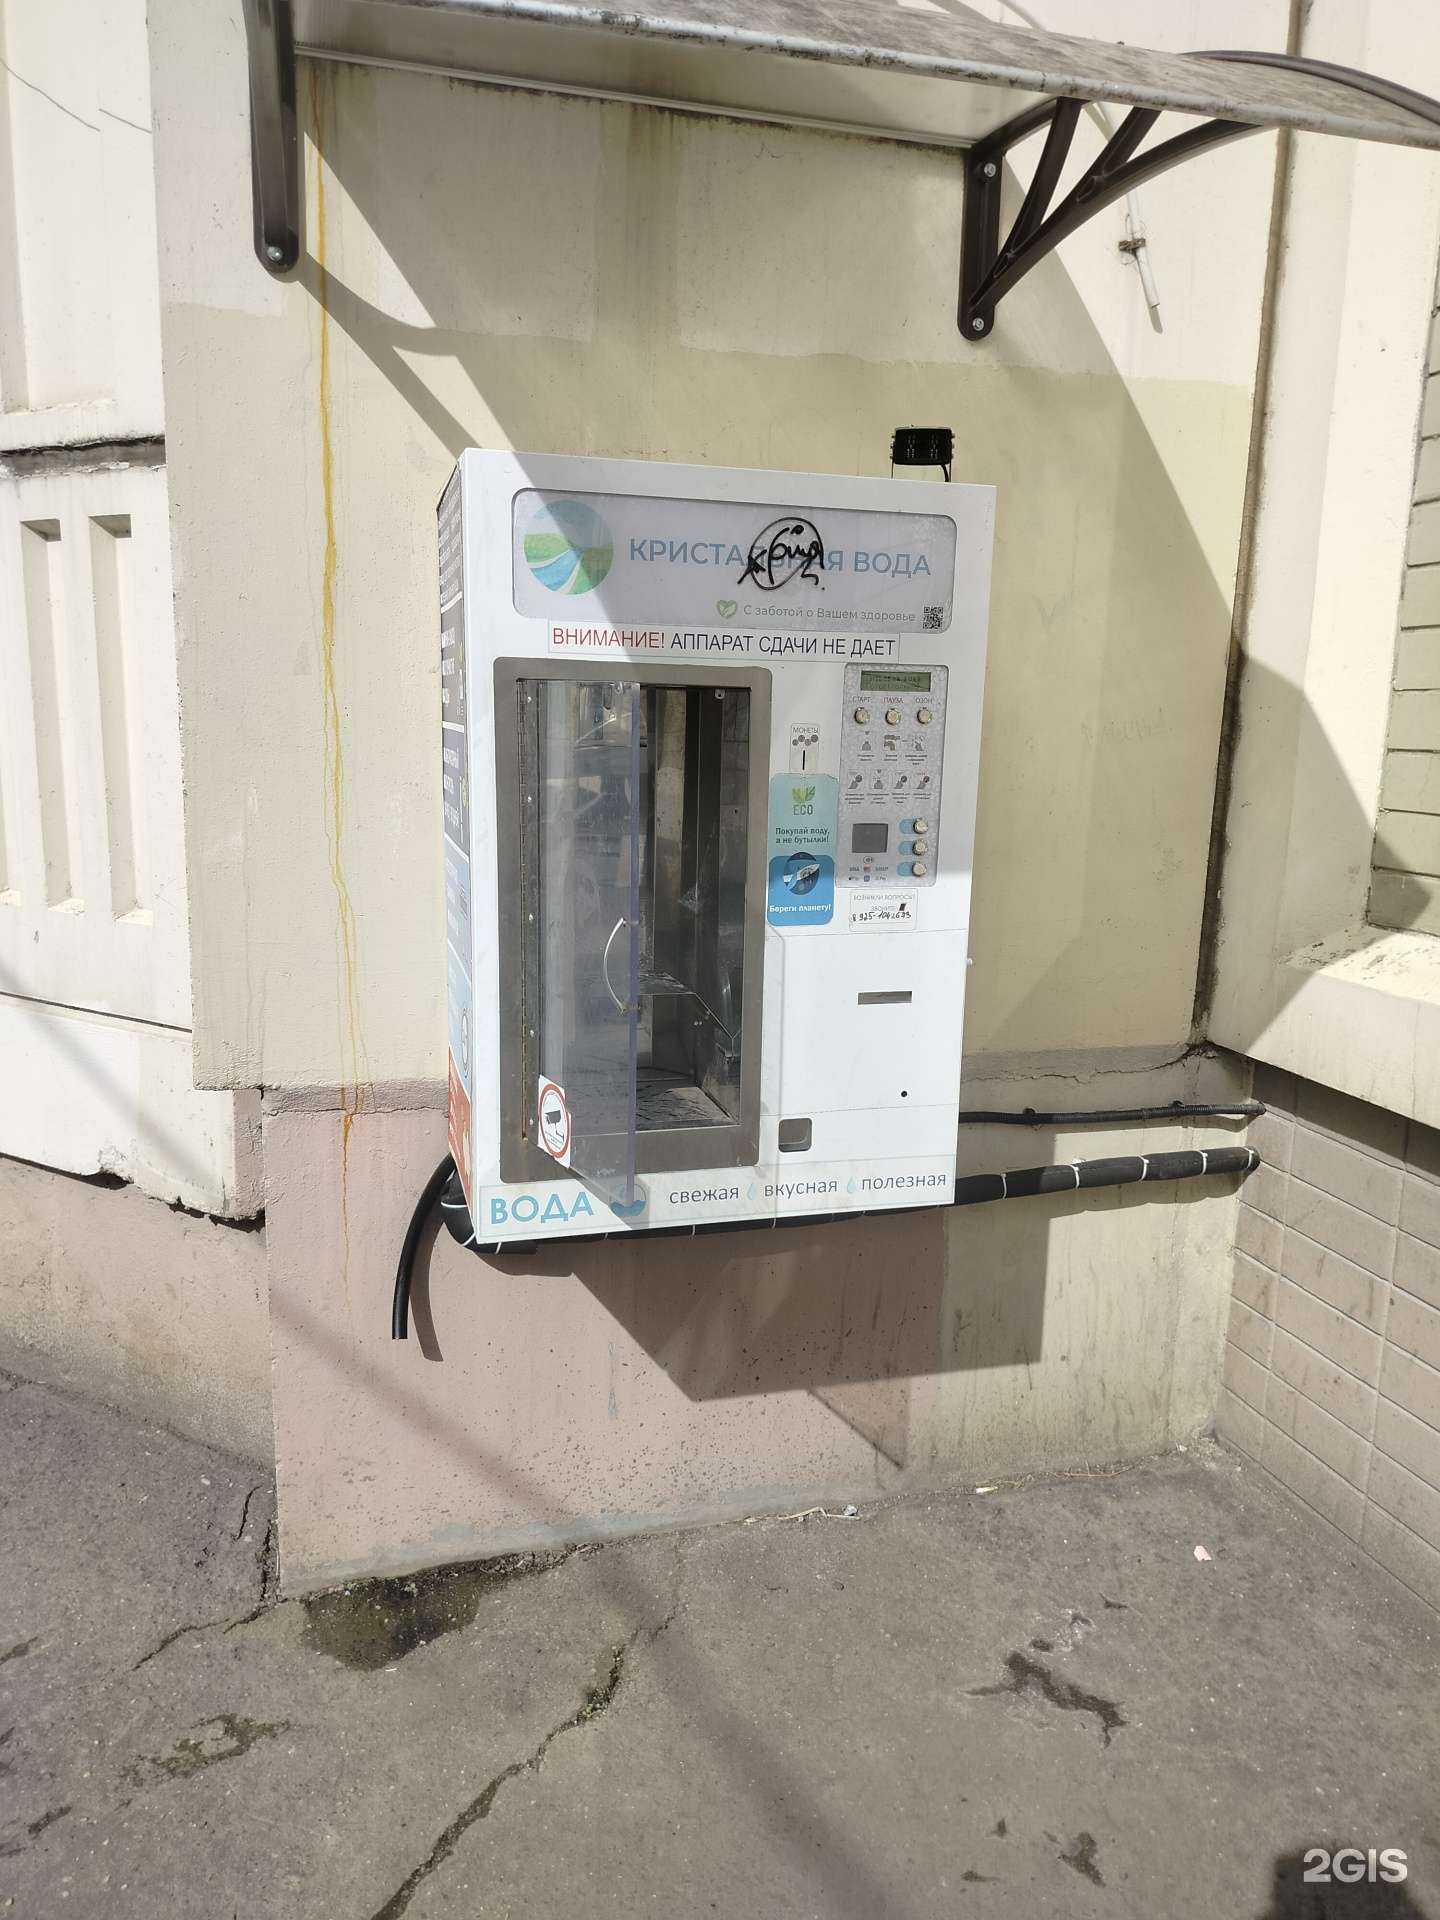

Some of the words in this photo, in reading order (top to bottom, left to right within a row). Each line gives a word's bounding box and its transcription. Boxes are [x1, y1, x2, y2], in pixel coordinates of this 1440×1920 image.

[853, 551, 932, 579] ВОДА
[743, 604, 753, 616] С
[755, 605, 803, 618] заботой
[806, 609, 814, 618] о
[816, 607, 858, 620] Вашем
[861, 611, 916, 624] здоровье
[552, 627, 666, 649] ВНИМАНИЕ!
[670, 632, 754, 651] АППАРАТ
[758, 635, 817, 656] СДАЧИ
[823, 638, 846, 655] НЕ
[850, 639, 896, 658] ДАЕТ
[792, 726, 820, 734] МОНЕТЫ
[793, 804, 813, 816] ECO
[775, 826, 809, 837] Покупай
[810, 827, 830, 836] воду,
[769, 904, 797, 913] Береги
[798, 903, 831, 913] планету!
[669, 1187, 740, 1204] свежая
[764, 1179, 838, 1201] вкусная
[861, 1172, 947, 1191] полезная
[490, 1191, 595, 1225] ВОДА
